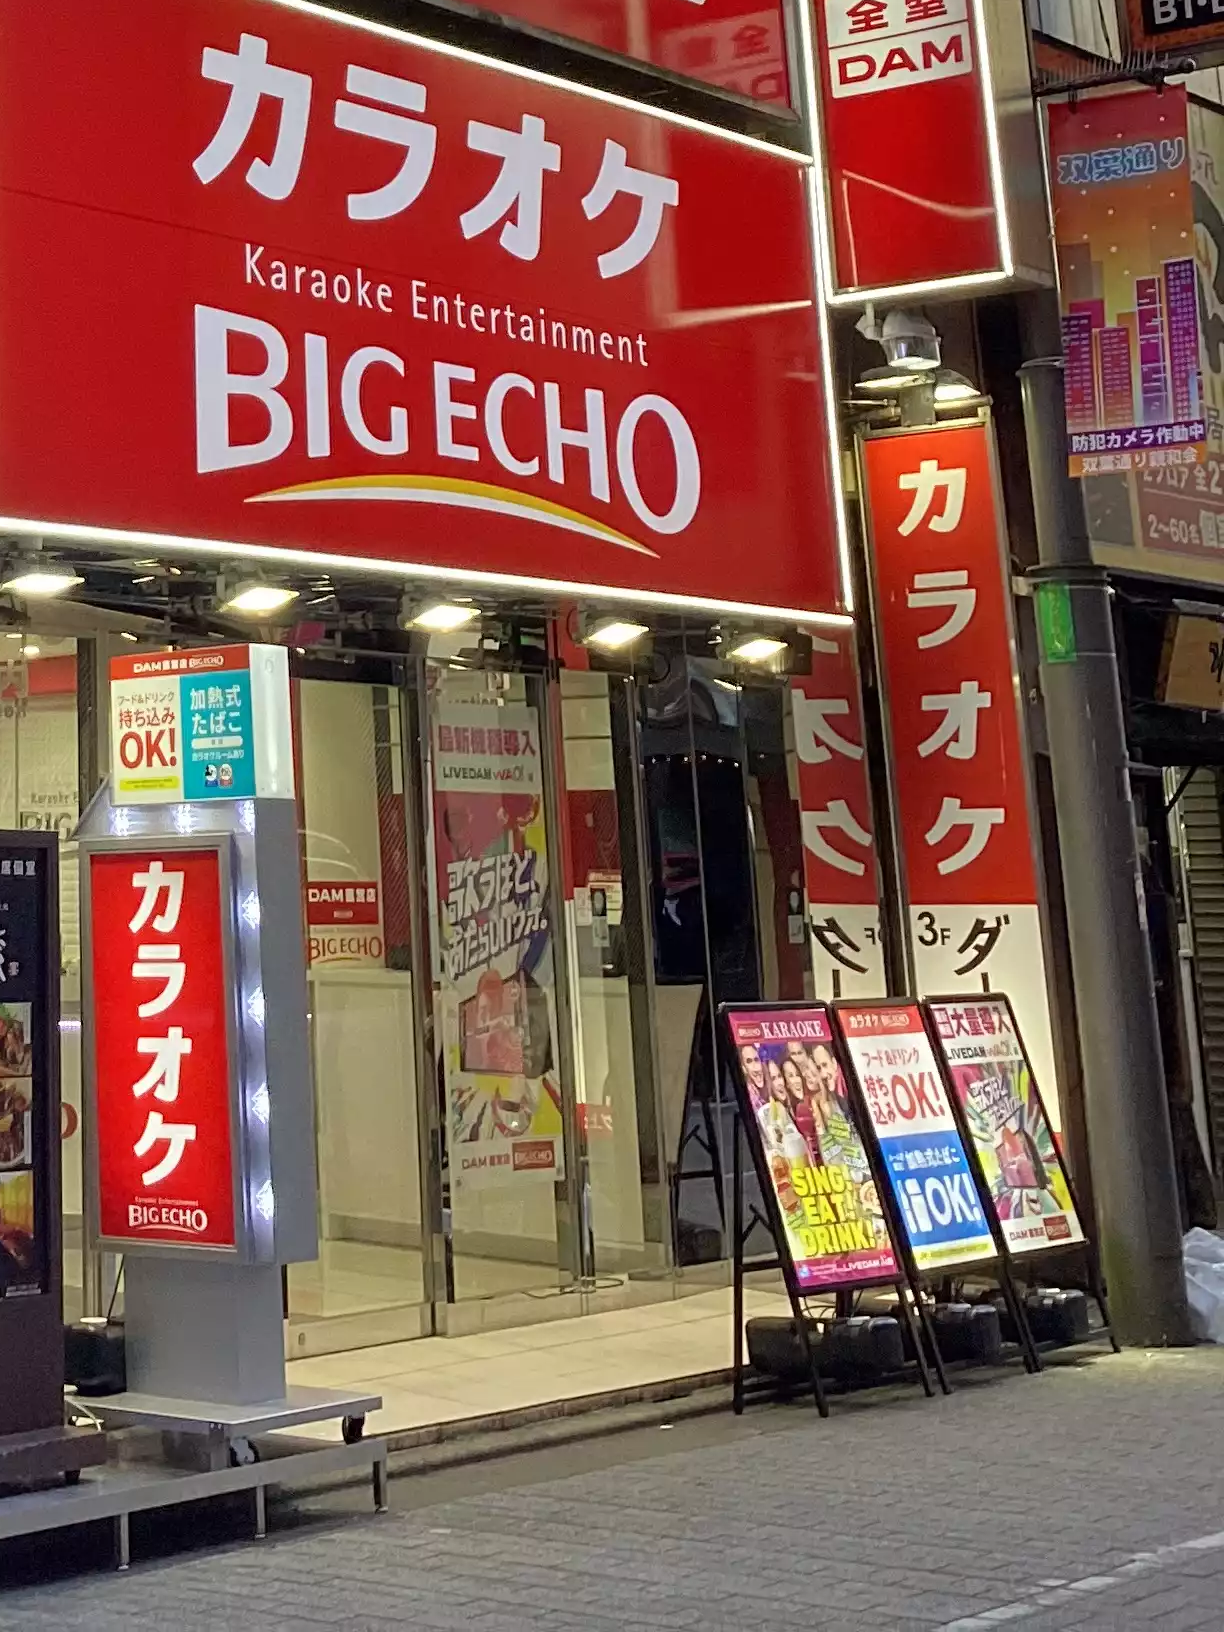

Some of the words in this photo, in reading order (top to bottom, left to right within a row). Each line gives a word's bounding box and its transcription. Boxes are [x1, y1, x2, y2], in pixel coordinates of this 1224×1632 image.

[838, 35, 965, 86] DAM
[192, 32, 680, 280] カラオケ
[1057, 137, 1185, 185] 双葉通り
[244, 242, 395, 314] Karaoke
[411, 279, 650, 368] Entertainment
[195, 303, 409, 475] BIG
[433, 360, 701, 536] ECHO
[1072, 422, 1204, 453] 防犯カメラ作動中
[898, 459, 1006, 876] カラオケ
[119, 707, 176, 728] 持ち込み
[190, 684, 241, 711] 加熱式
[192, 711, 242, 735] たばこ
[120, 728, 177, 769] OK!
[917, 911, 952, 946] 3F
[308, 936, 337, 963] BIG
[340, 935, 383, 959] ECHO
[128, 860, 197, 1187] カラオケ
[761, 1020, 825, 1039] KARAOKE
[891, 1071, 946, 1121] OK!
[792, 1165, 853, 1198] SING!
[925, 1172, 982, 1226] OK!
[128, 1204, 160, 1227] BIG
[161, 1207, 208, 1232] ECHO
[802, 1192, 856, 1226] EAT!
[799, 1218, 876, 1258] DRINK!
